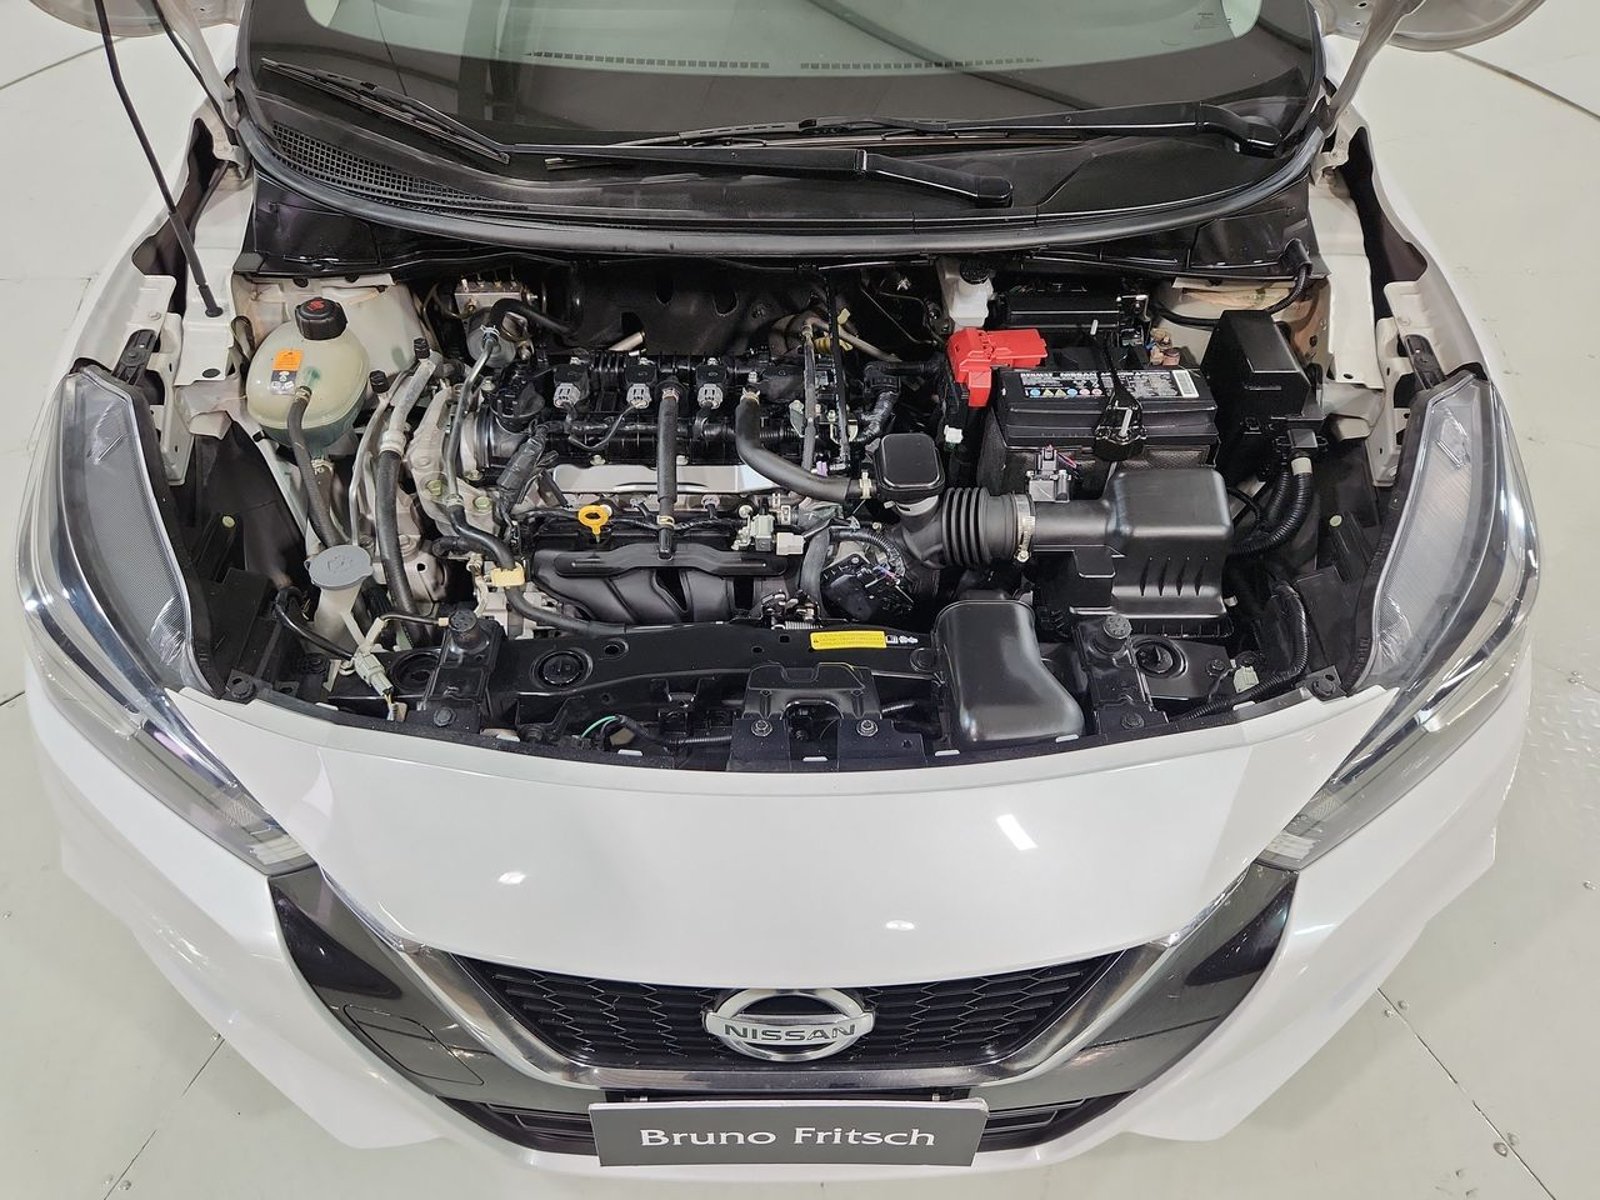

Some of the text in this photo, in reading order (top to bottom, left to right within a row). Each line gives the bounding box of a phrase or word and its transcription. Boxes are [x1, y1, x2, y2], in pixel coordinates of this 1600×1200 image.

[724, 1024, 856, 1041] NISSAN
[640, 1127, 935, 1146] Bruno Fritsch
